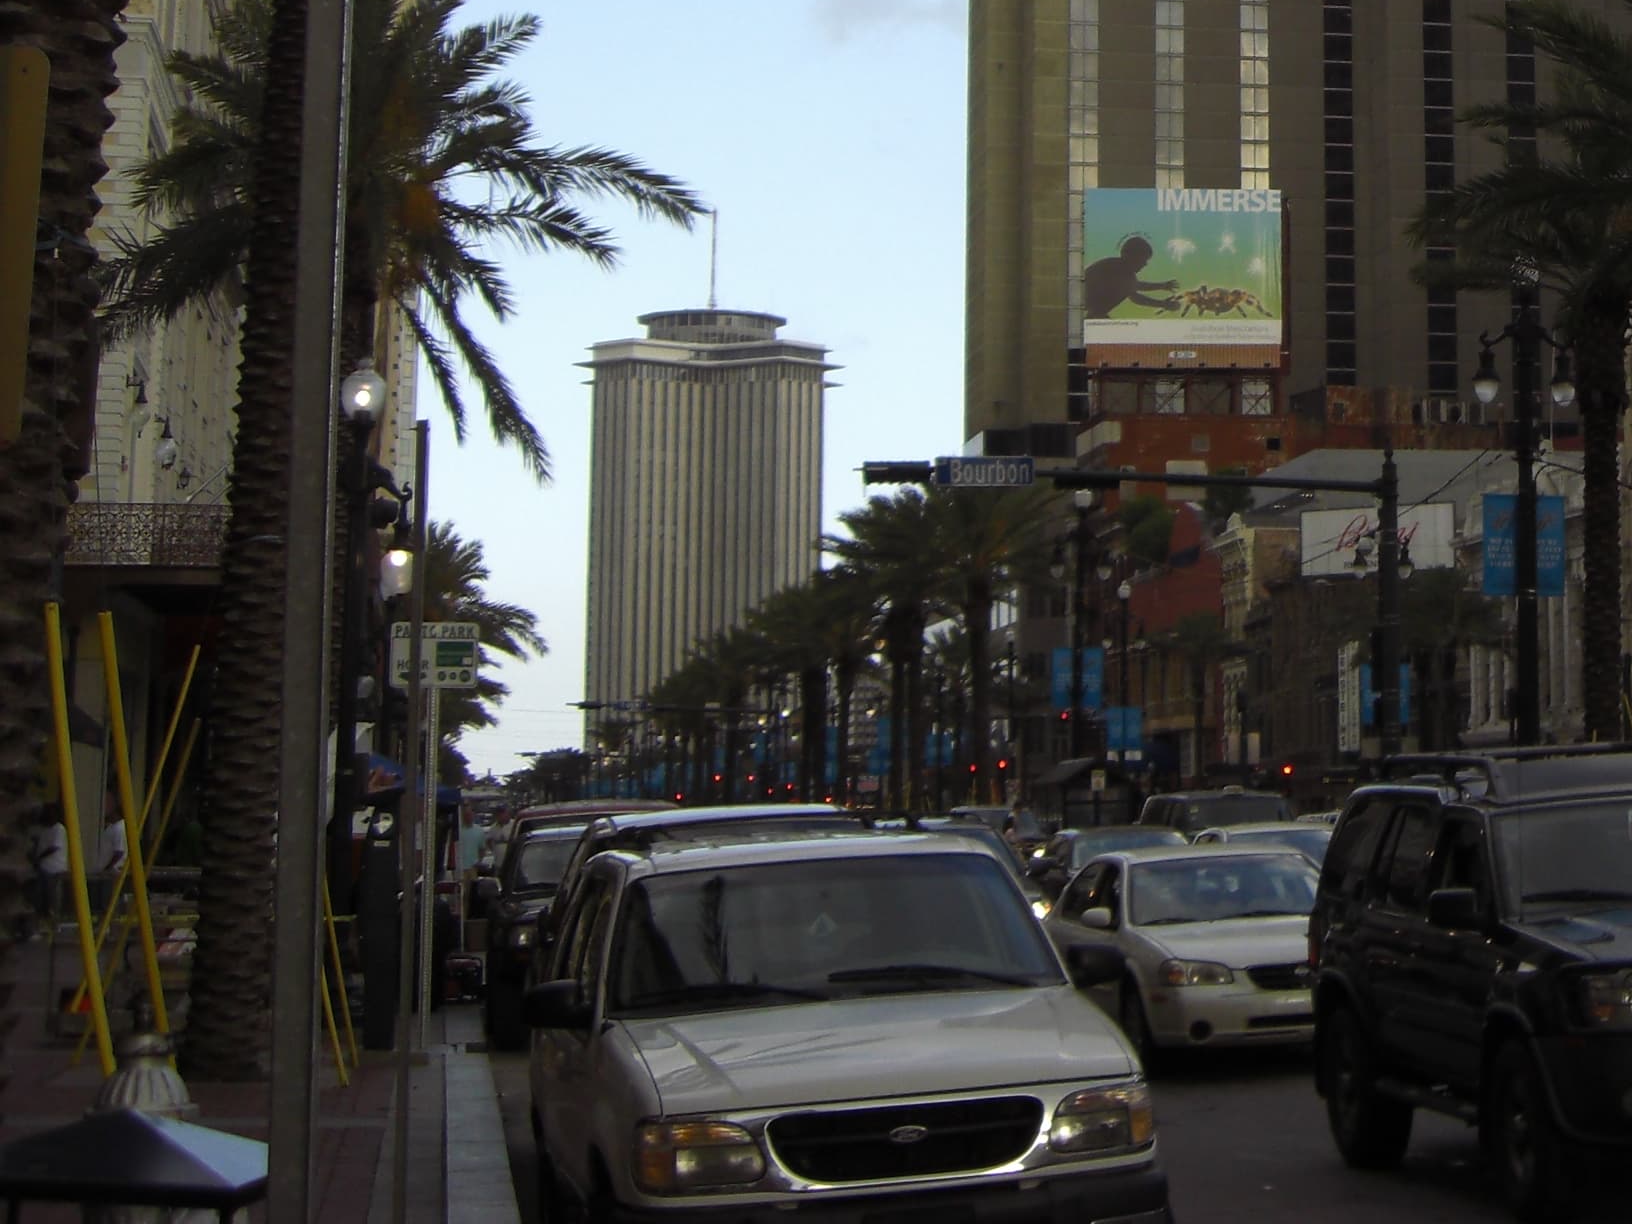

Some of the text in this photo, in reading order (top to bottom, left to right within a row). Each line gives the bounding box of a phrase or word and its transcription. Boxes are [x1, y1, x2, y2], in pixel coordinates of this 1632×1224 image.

[1157, 188, 1282, 213] IMMERSE
[949, 458, 1031, 485] Bourbon
[440, 625, 474, 639] PARK
[397, 659, 429, 671] HOR
